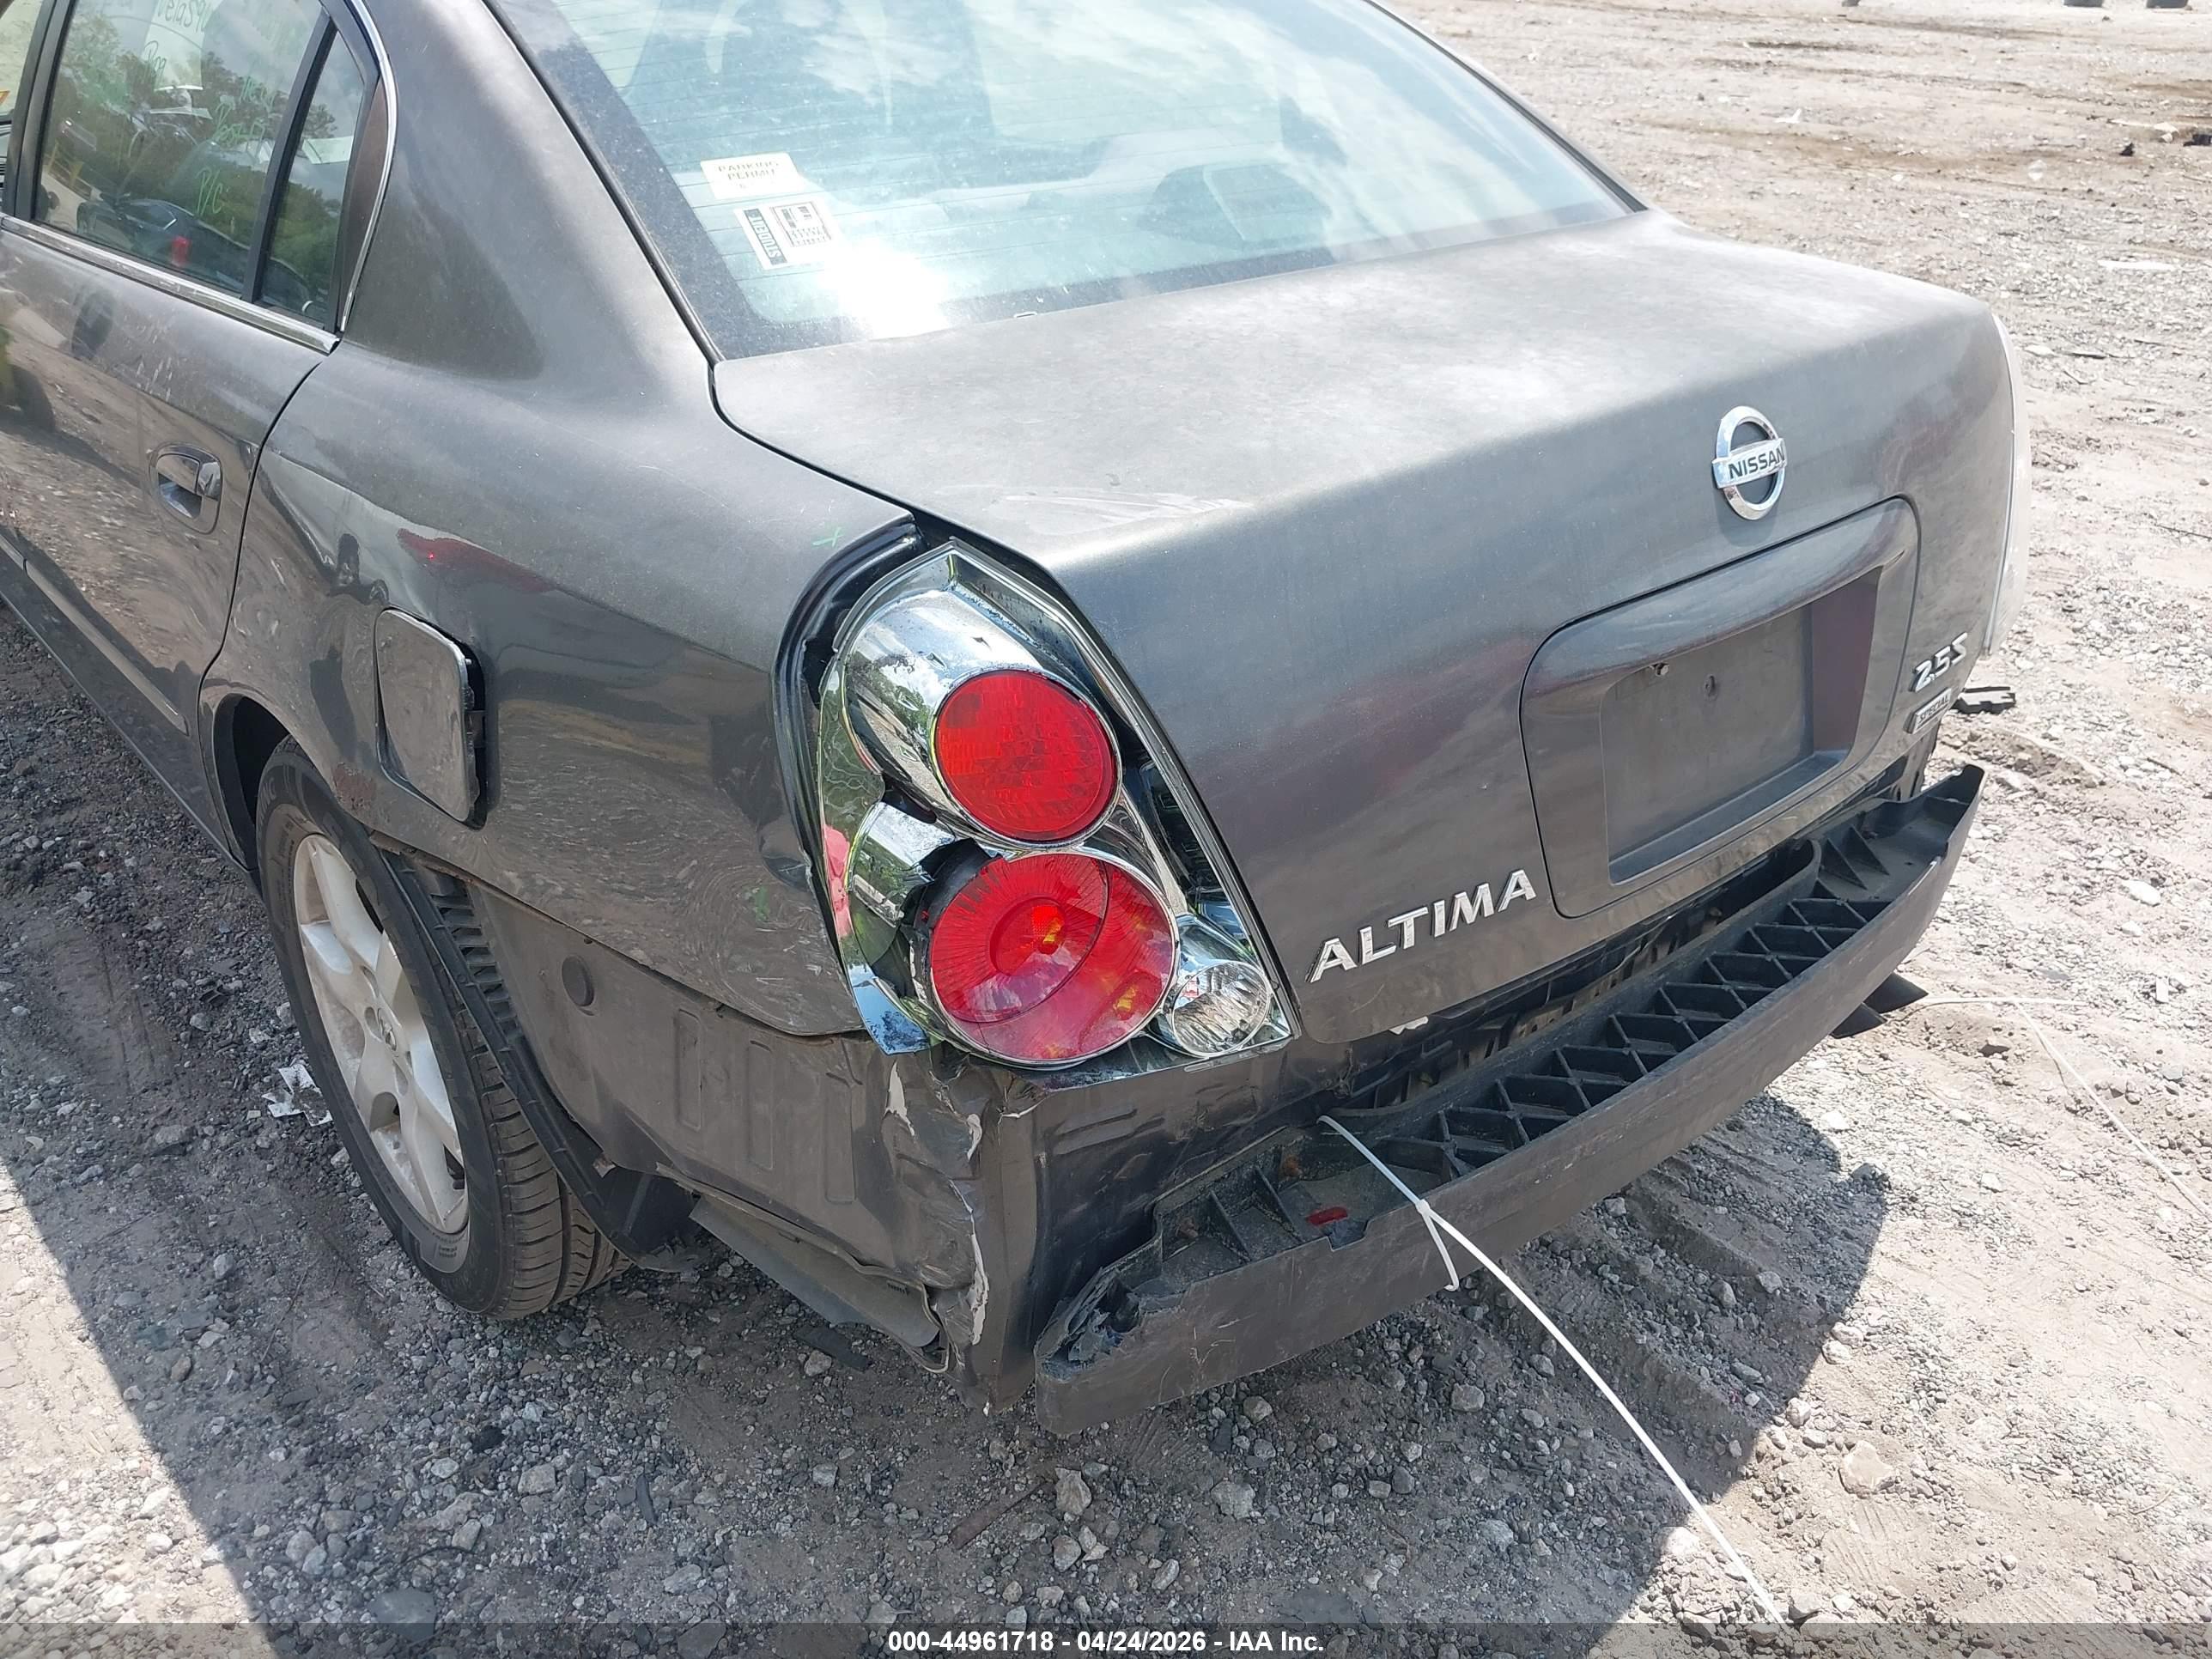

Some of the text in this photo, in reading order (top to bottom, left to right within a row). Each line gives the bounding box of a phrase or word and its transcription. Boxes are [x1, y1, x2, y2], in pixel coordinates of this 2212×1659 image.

[1728, 446, 1786, 480] NISSAN
[1917, 691, 1950, 724] SPECIAL
[1304, 868, 1537, 983] ALTIMA
